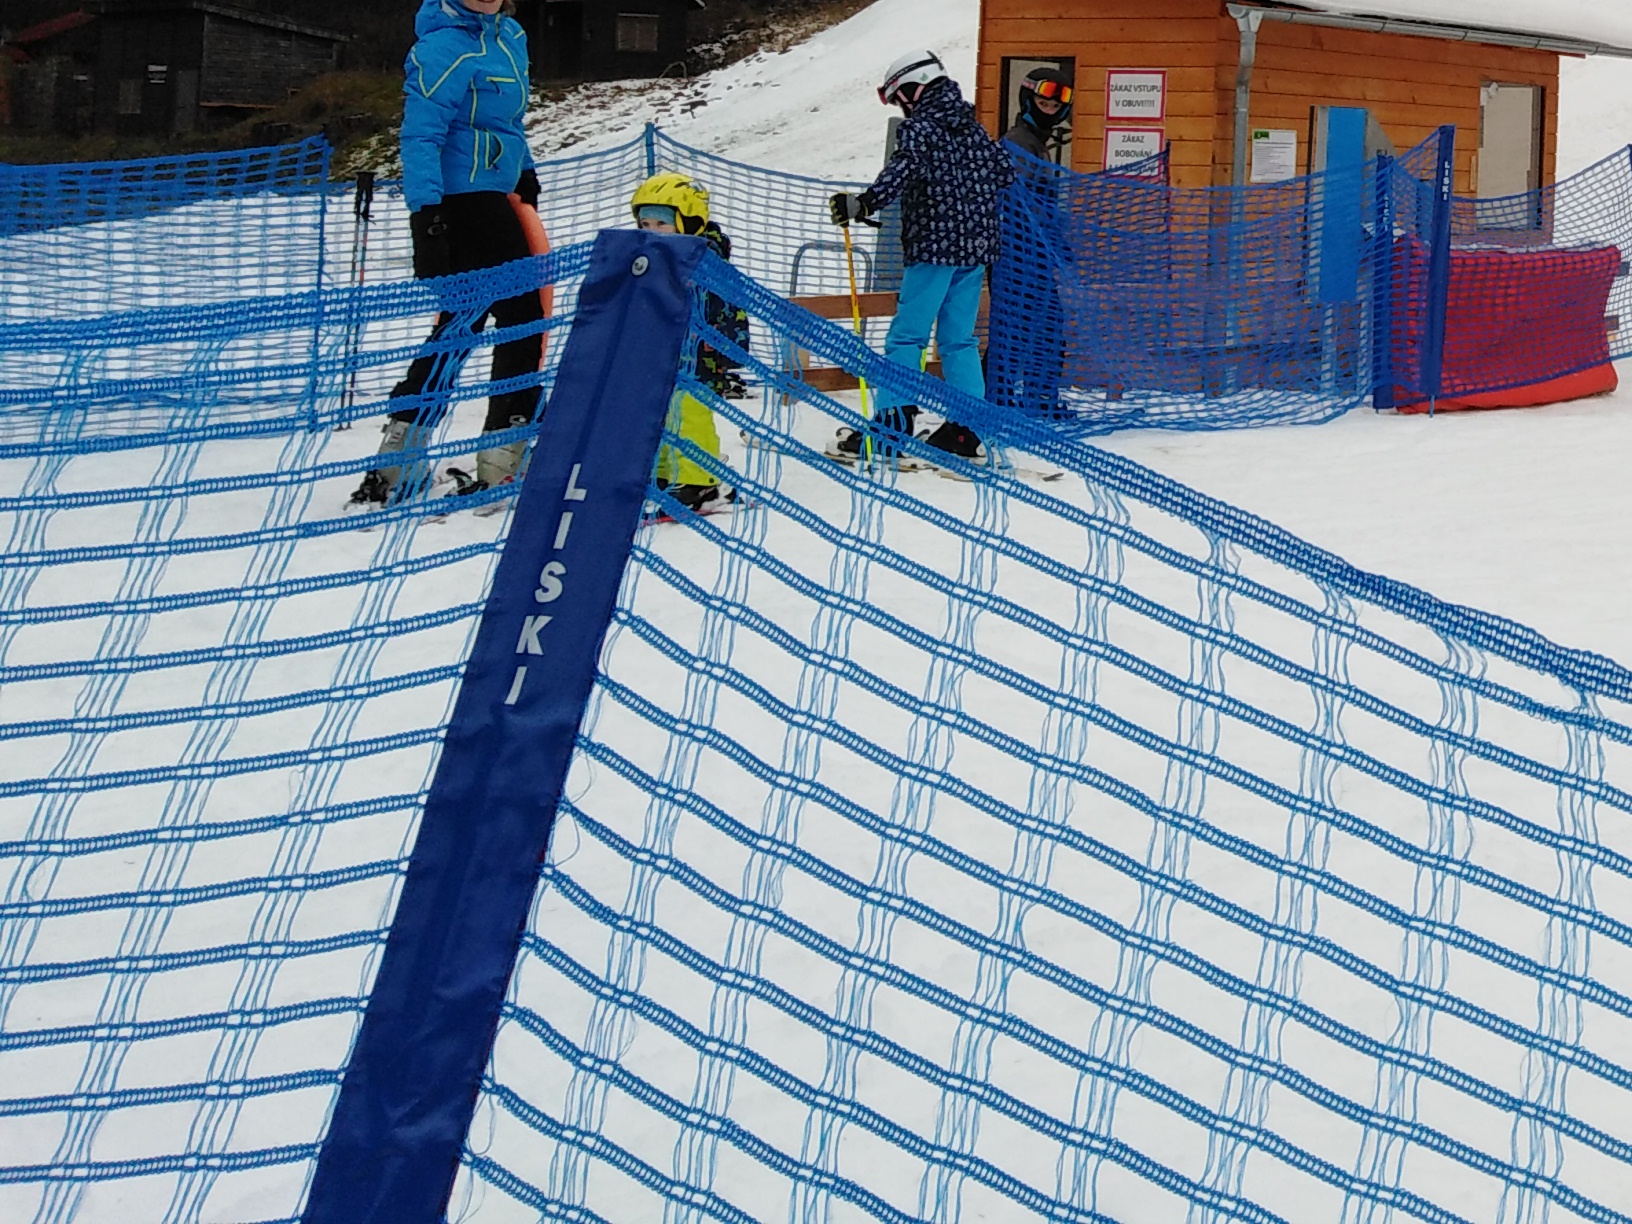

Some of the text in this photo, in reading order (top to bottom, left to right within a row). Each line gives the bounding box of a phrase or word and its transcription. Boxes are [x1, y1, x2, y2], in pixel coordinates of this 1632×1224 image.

[1110, 84, 1162, 93] ZÁKAZ VSTUPU
[1115, 99, 1121, 108] V
[1121, 134, 1145, 144] ZÁKAZ
[1442, 161, 1450, 201] LISKI
[503, 462, 588, 705] LISKI
